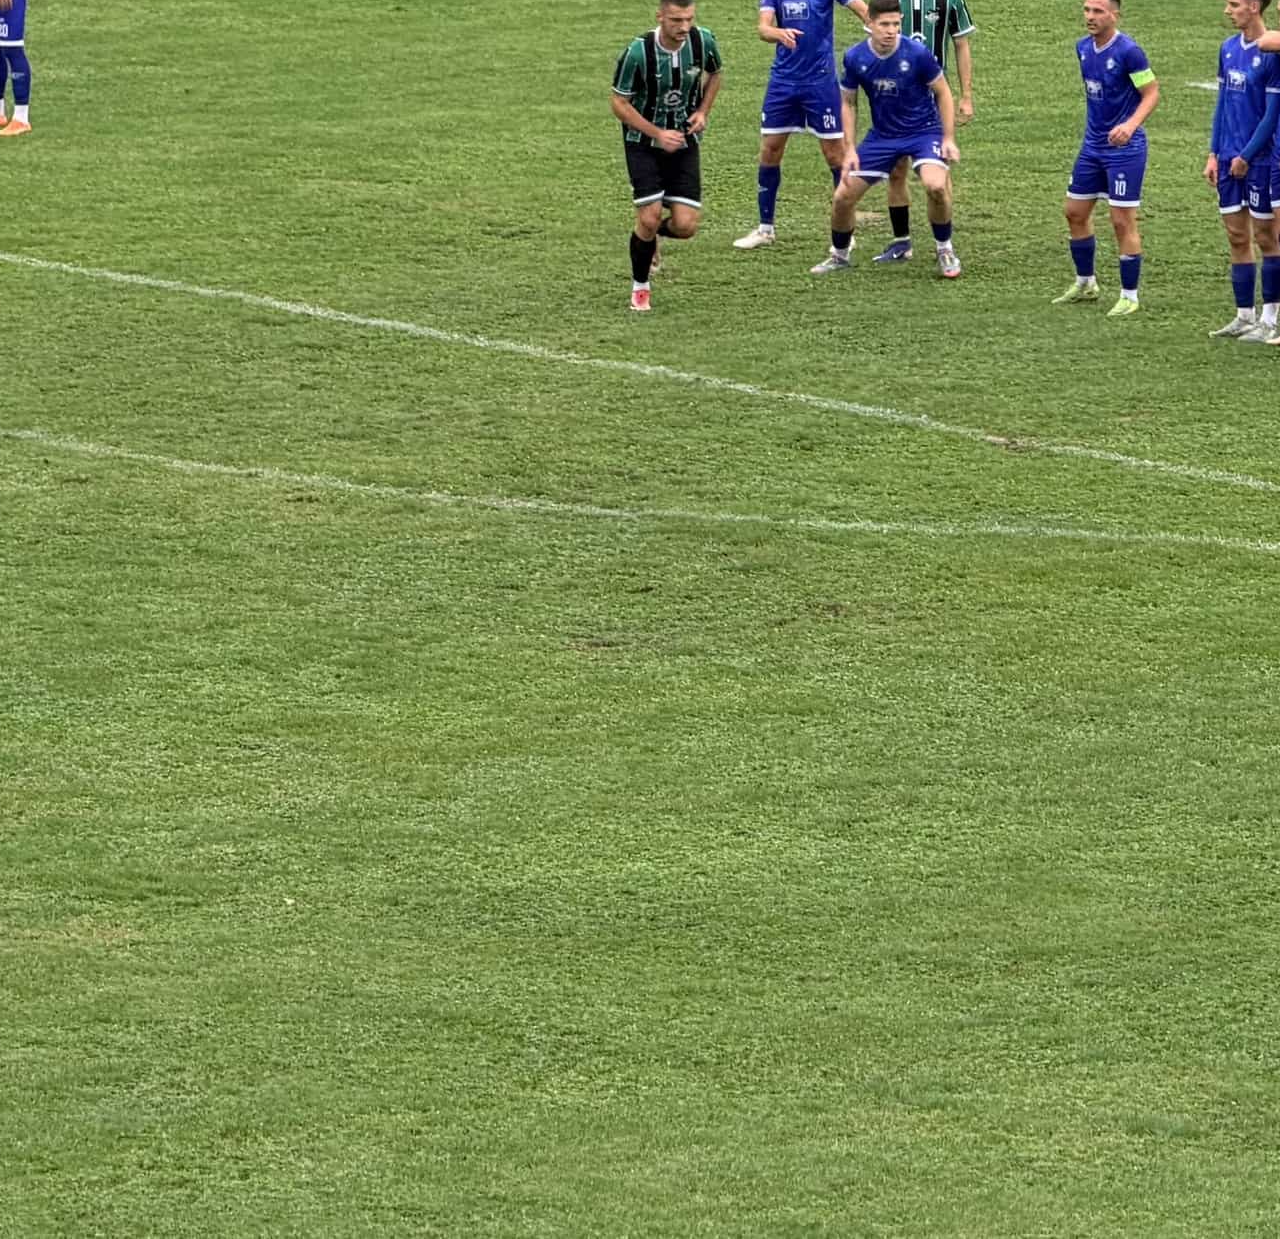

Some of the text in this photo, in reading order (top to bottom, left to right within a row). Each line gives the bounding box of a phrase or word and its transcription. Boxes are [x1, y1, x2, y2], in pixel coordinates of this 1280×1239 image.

[823, 115, 836, 129] 24
[1115, 181, 1126, 196] 10
[1249, 190, 1260, 207] 19
